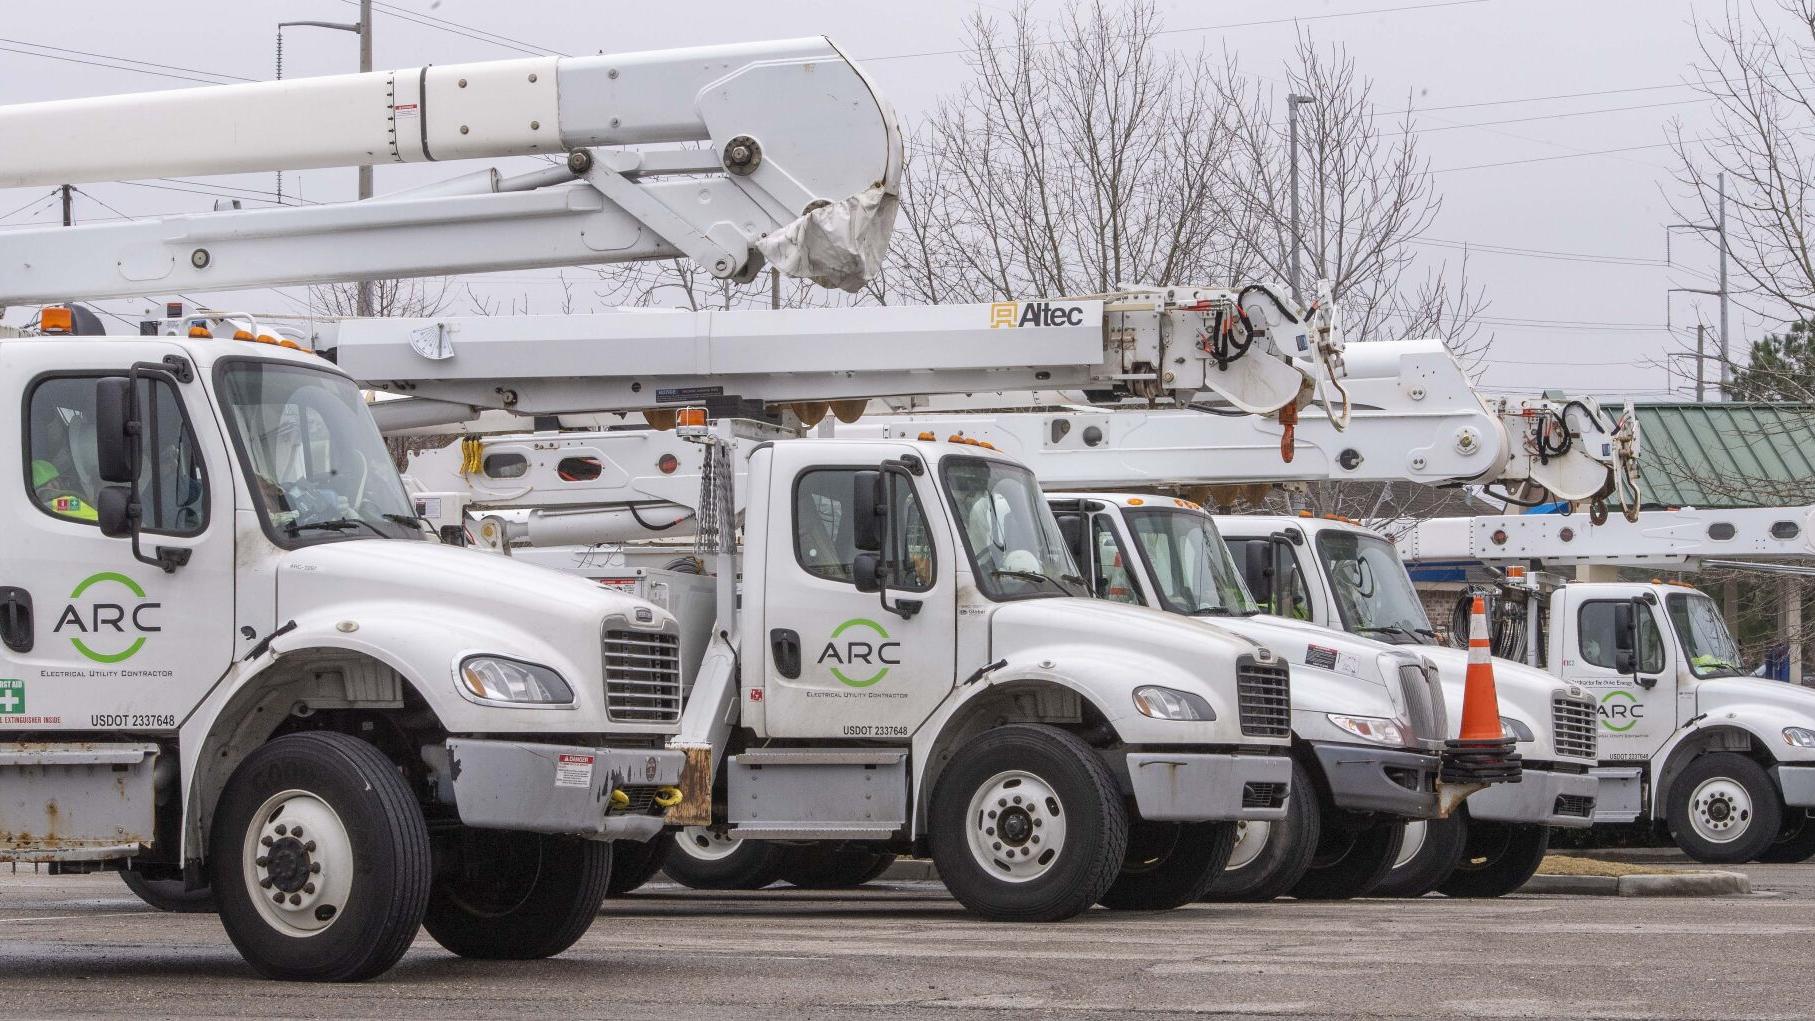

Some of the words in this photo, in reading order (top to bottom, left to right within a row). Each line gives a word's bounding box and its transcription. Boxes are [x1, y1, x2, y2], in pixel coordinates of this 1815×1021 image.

[1018, 302, 1083, 327] Altec
[53, 603, 161, 632] ARC
[817, 642, 901, 665] ARC
[1597, 704, 1644, 718] ARC
[91, 715, 129, 727] USDOT
[132, 714, 175, 727] 2337648
[843, 725, 873, 736] USDOT
[874, 726, 908, 736] 2337648
